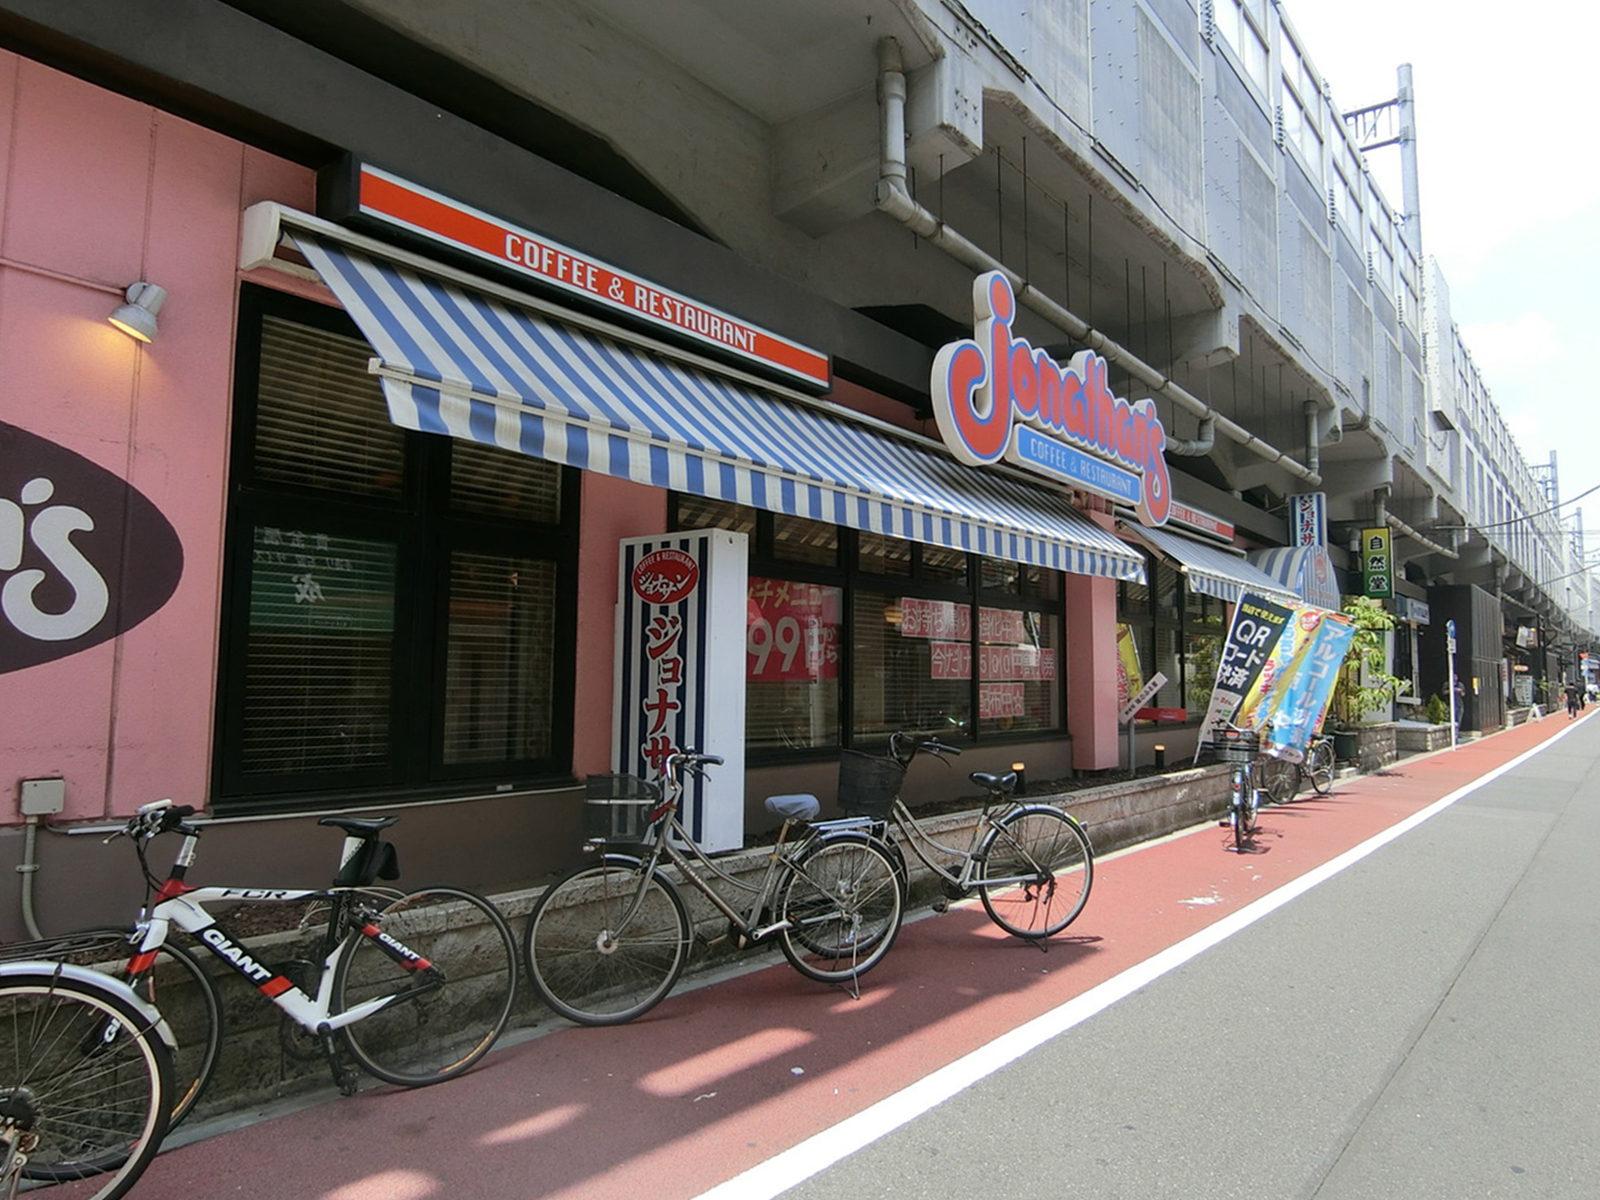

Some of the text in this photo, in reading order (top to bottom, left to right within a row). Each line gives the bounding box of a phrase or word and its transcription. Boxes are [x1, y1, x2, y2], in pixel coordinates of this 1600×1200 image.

[504, 233, 757, 353] COFFEE & RESTAURANT
[1030, 437, 1132, 496] COFFEE & RESTAURANT
[636, 554, 656, 575] COFFEE
[662, 551, 696, 571] RESTAURANT
[1368, 534, 1387, 592] 自然堂
[1236, 619, 1272, 647] QR
[932, 647, 971, 674] 今だけ
[1225, 643, 1265, 667] コード
[1219, 663, 1250, 689] 決済
[221, 889, 287, 899] FCR
[203, 928, 273, 981] GIANT
[378, 933, 421, 960] GIANT
